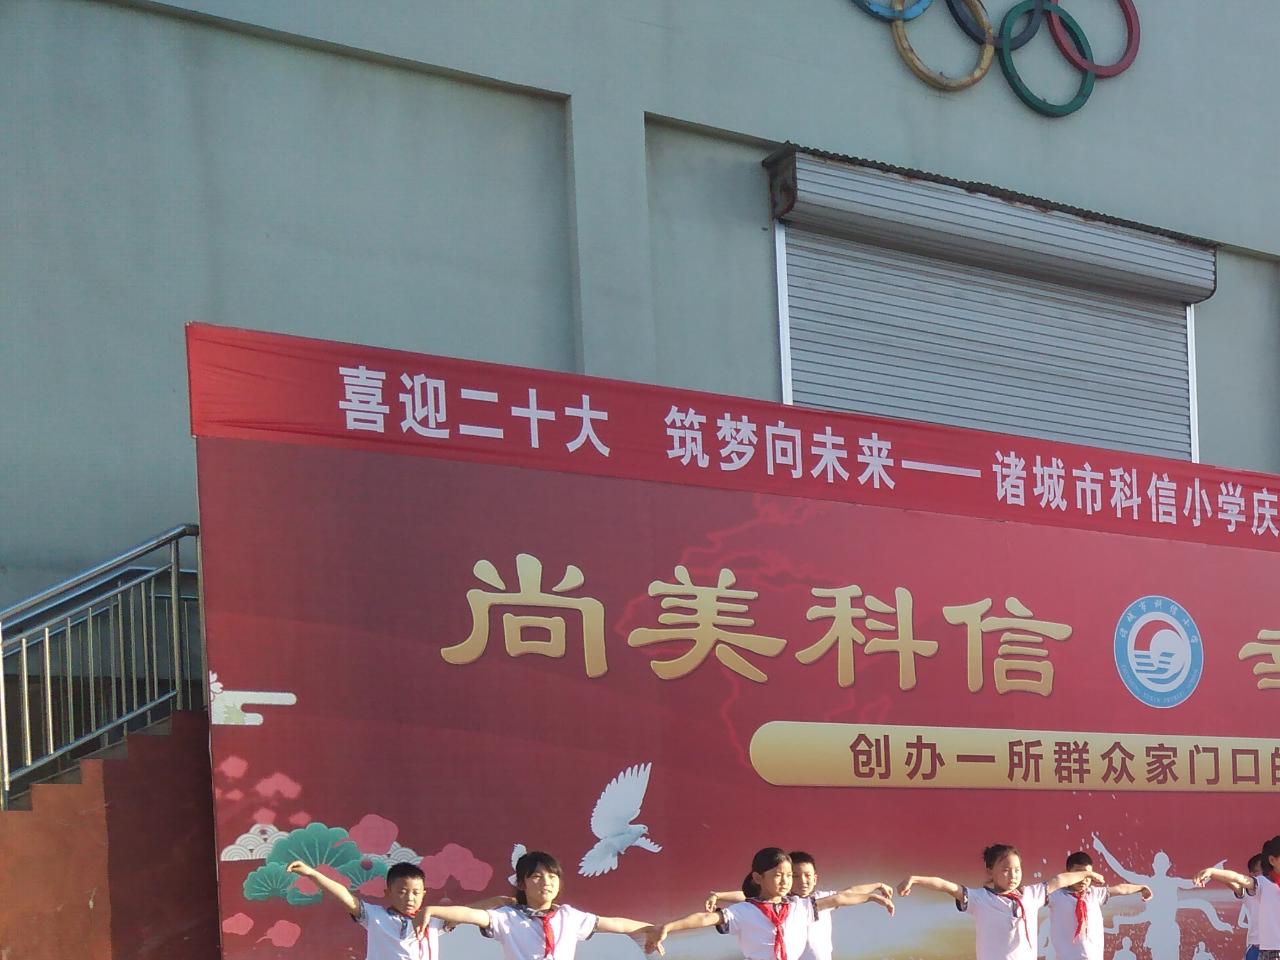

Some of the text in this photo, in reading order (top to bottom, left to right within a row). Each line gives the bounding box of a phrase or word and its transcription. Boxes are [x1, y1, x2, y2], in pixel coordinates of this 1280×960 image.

[338, 365, 610, 457] 喜迎二十大
[441, 553, 1073, 697] 尚美科信
